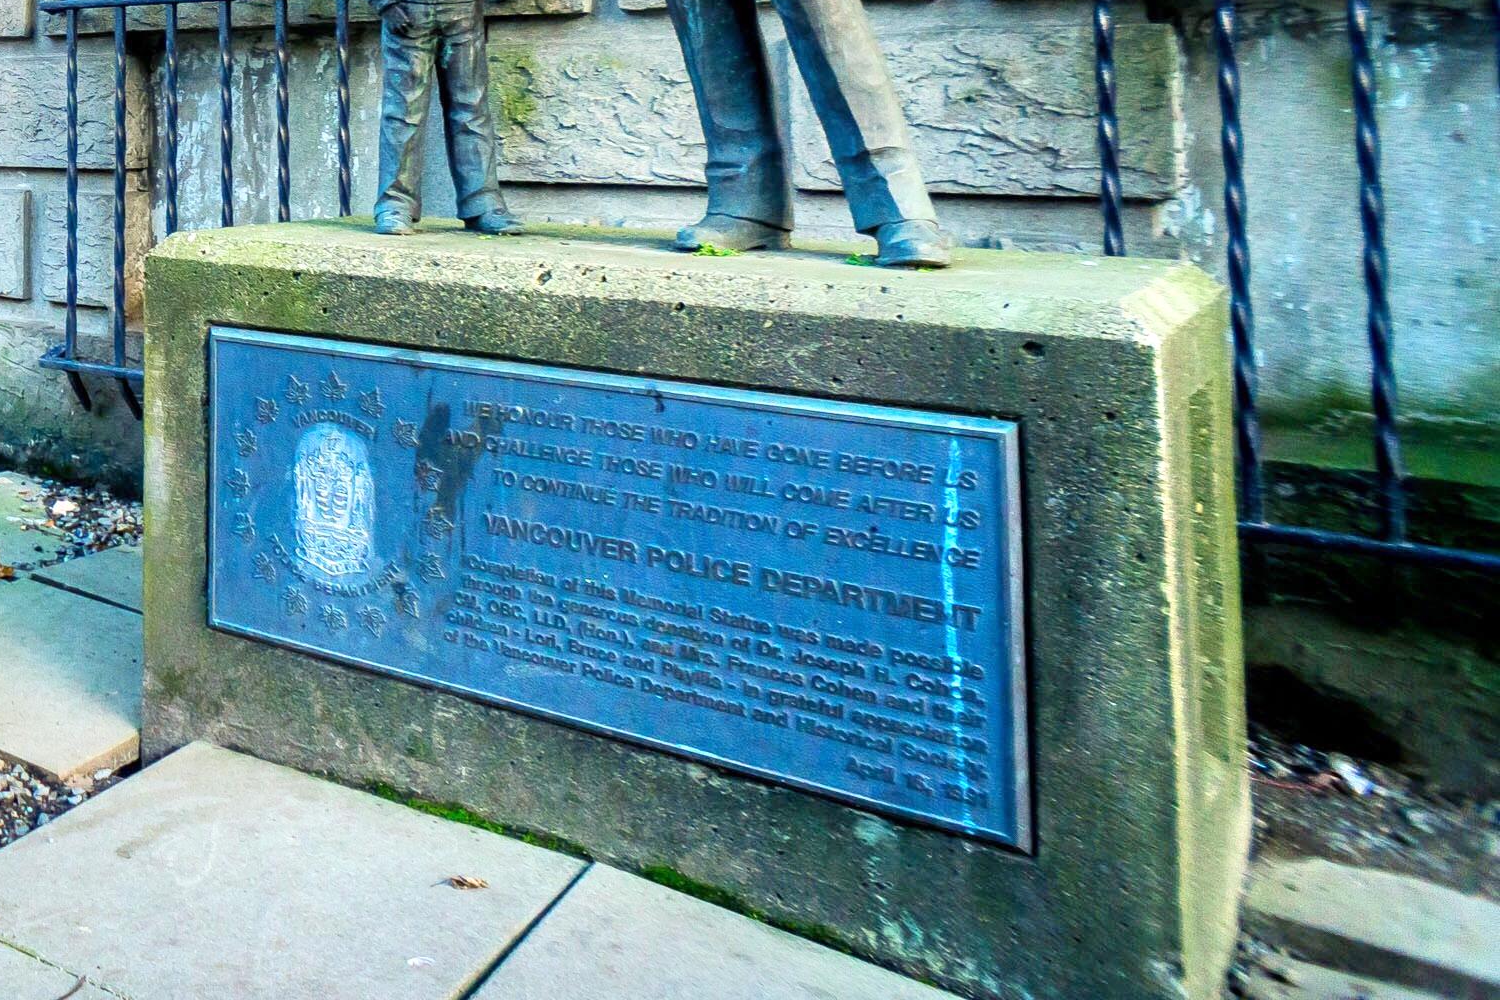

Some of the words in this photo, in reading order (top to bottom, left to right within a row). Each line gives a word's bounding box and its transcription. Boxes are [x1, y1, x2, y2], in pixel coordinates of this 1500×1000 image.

[444, 429, 482, 448] AND
[485, 435, 593, 468] CHALLENGE
[602, 454, 663, 479] THOSE
[670, 463, 718, 489] WHO
[726, 472, 775, 498] WILL
[782, 482, 852, 509] COME
[856, 494, 937, 523] AFTER
[465, 401, 491, 419] WE
[498, 403, 576, 431] HONOUR
[580, 416, 644, 442] THOSE
[652, 427, 698, 450] WHO
[707, 435, 760, 459] HAVE
[767, 443, 830, 469] GONE
[838, 453, 935, 484] BEFORE
[494, 468, 517, 487] TO
[523, 474, 619, 505] CONTINUE
[622, 491, 662, 514] THE
[670, 499, 779, 534] TRADITION
[784, 520, 819, 540] OF
[825, 527, 982, 569] EXCELLENCE
[483, 513, 639, 564] VANCOUVER
[646, 544, 751, 587] POLICE
[761, 568, 983, 630] DEPARTMENT
[562, 576, 581, 592] of
[584, 580, 617, 601] this
[620, 587, 704, 620] Memorial
[709, 606, 772, 635] Statue
[777, 624, 821, 645] was
[825, 634, 884, 658] made
[446, 609, 510, 637] children
[567, 638, 618, 662] Bruce
[622, 655, 655, 674] and
[662, 663, 723, 690] Phyllis
[768, 689, 845, 720] grateful
[462, 574, 523, 602] through
[529, 589, 556, 606] the
[559, 599, 640, 627] generous
[643, 616, 725, 647] donation
[731, 636, 752, 651] of
[756, 639, 784, 660] Dr.
[792, 649, 866, 681] Joseph
[641, 638, 675, 656] and
[680, 645, 720, 667] Mrs.
[726, 654, 805, 687] Frances
[811, 674, 877, 703] Cohen
[884, 695, 925, 715] and
[444, 629, 459, 643] of
[463, 632, 491, 651] the
[490, 638, 578, 674] Vancouver
[582, 662, 635, 688] Police
[640, 676, 747, 717] Department
[752, 707, 788, 728] and
[796, 715, 894, 752] Historical
